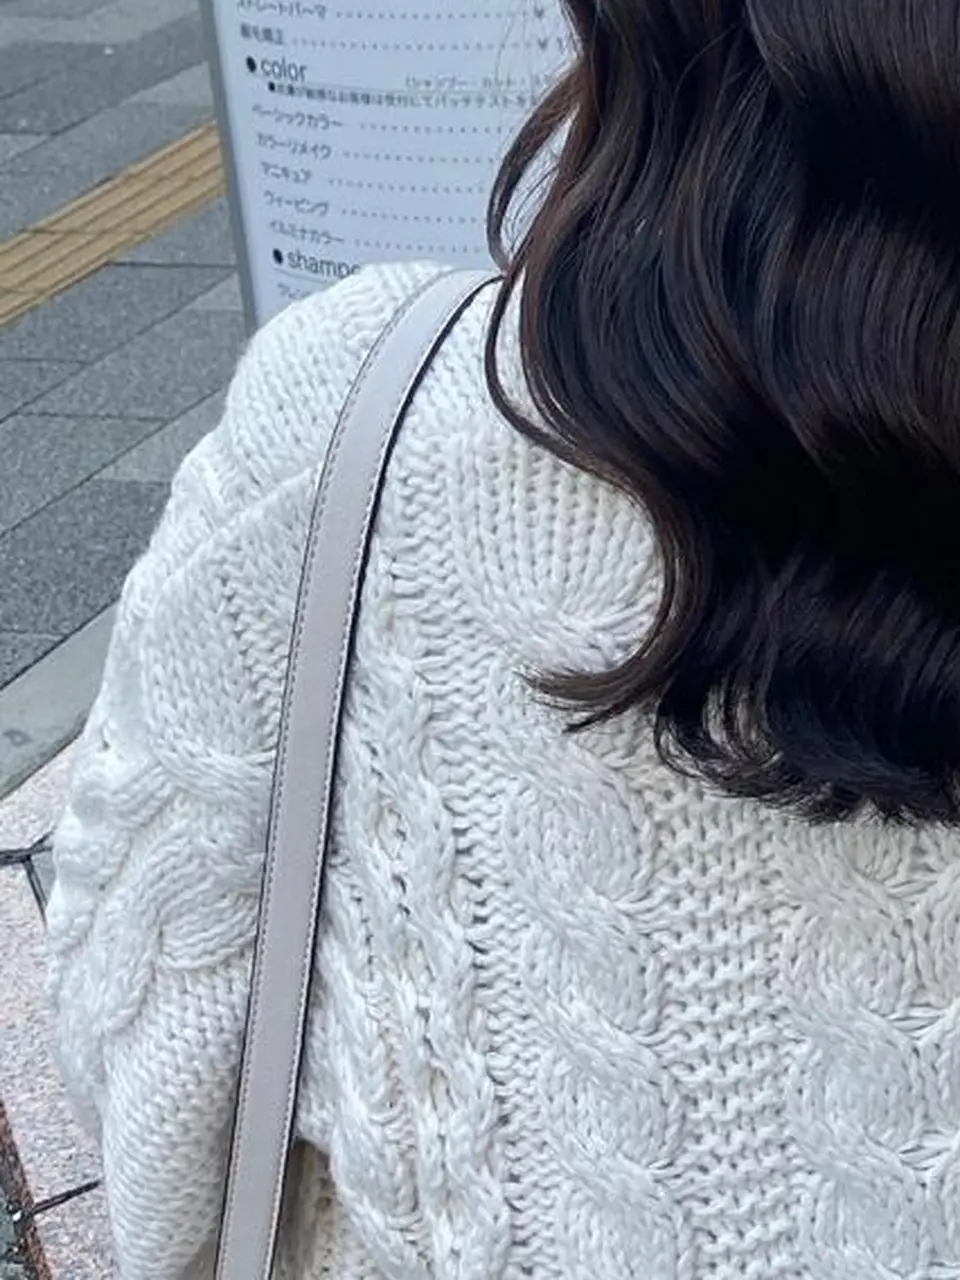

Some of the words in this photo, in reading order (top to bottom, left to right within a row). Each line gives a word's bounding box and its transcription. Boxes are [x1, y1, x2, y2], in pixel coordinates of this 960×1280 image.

[260, 55, 307, 82] color
[251, 102, 343, 131] ベーシックカラー
[256, 131, 333, 160] カラーリメイク
[260, 160, 313, 185] マニキュア
